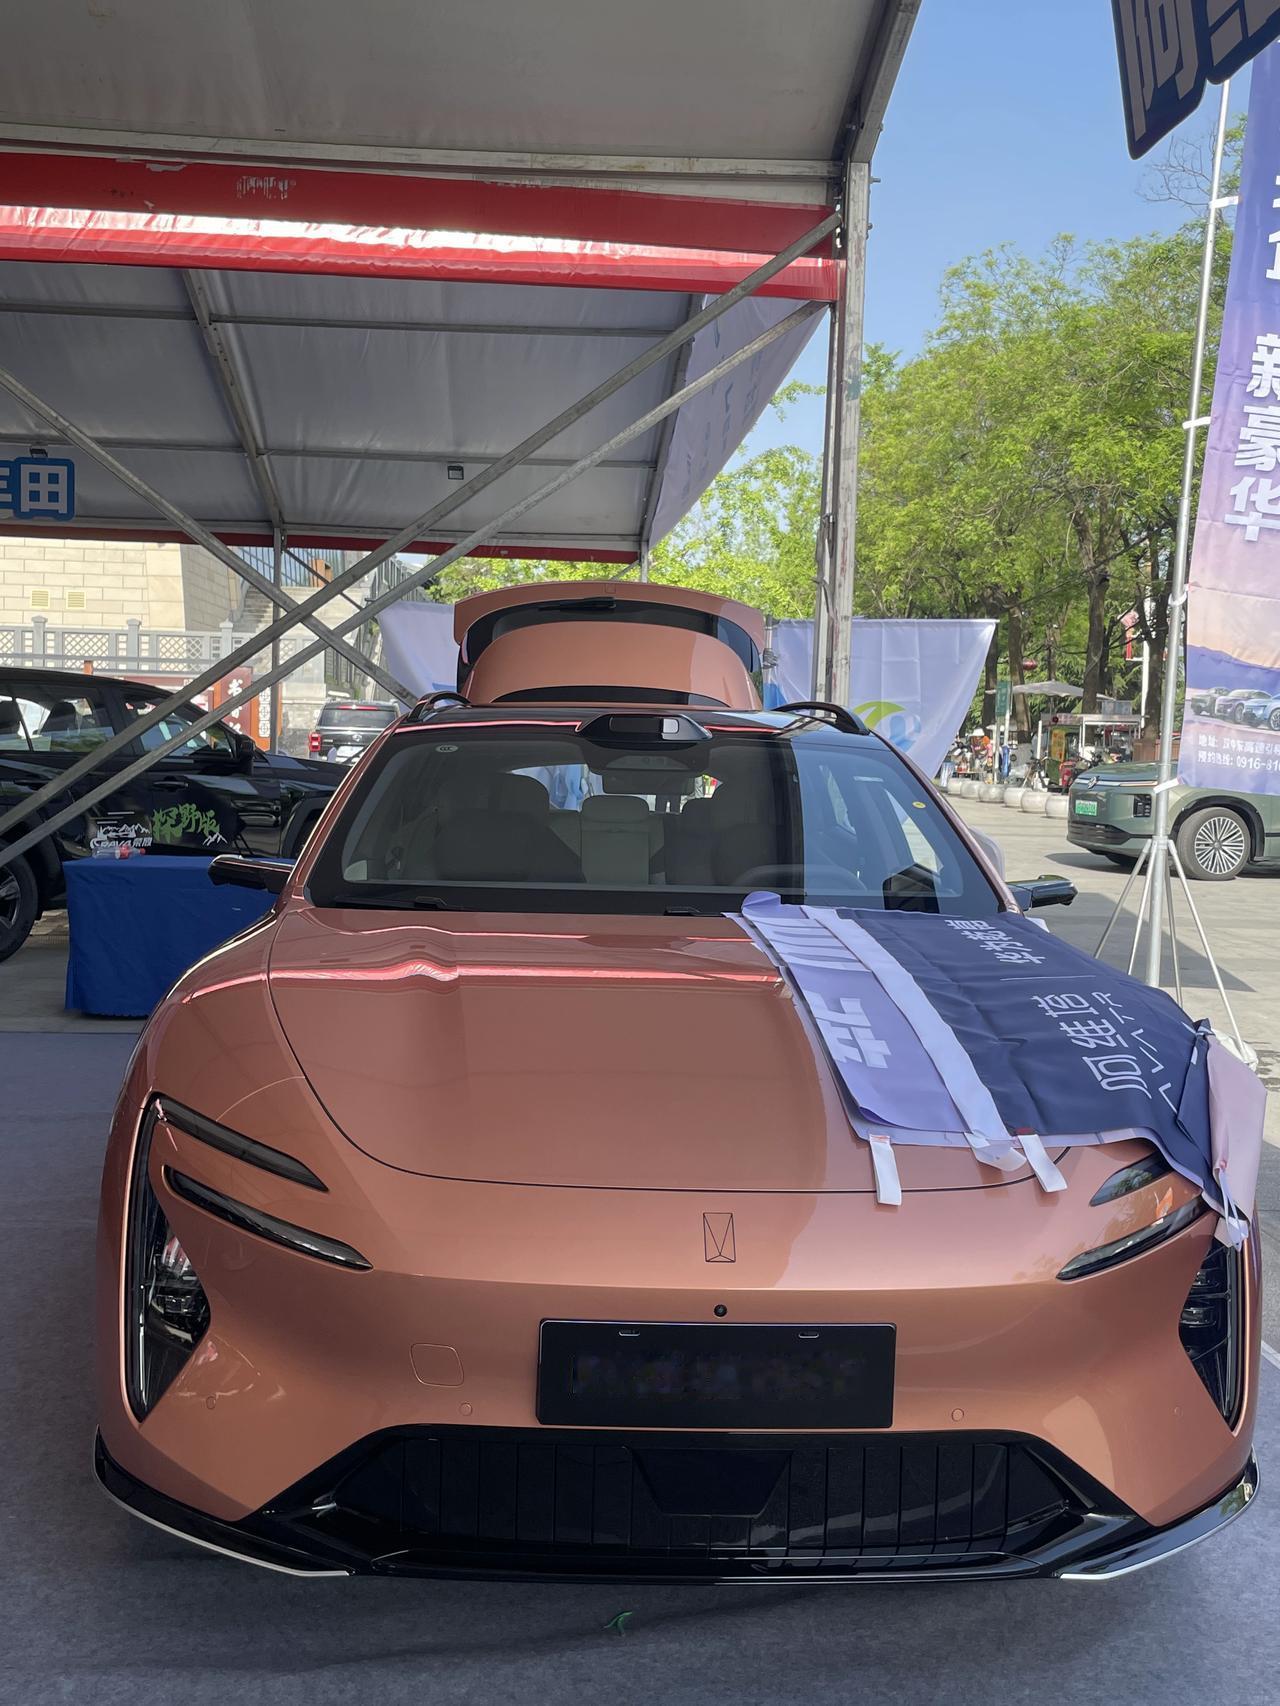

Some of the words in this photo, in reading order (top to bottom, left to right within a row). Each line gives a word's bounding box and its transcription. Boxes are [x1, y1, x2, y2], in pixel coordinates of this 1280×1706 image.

[0, 464, 67, 514] 田
[1030, 992, 1153, 1099] 阿维塔
